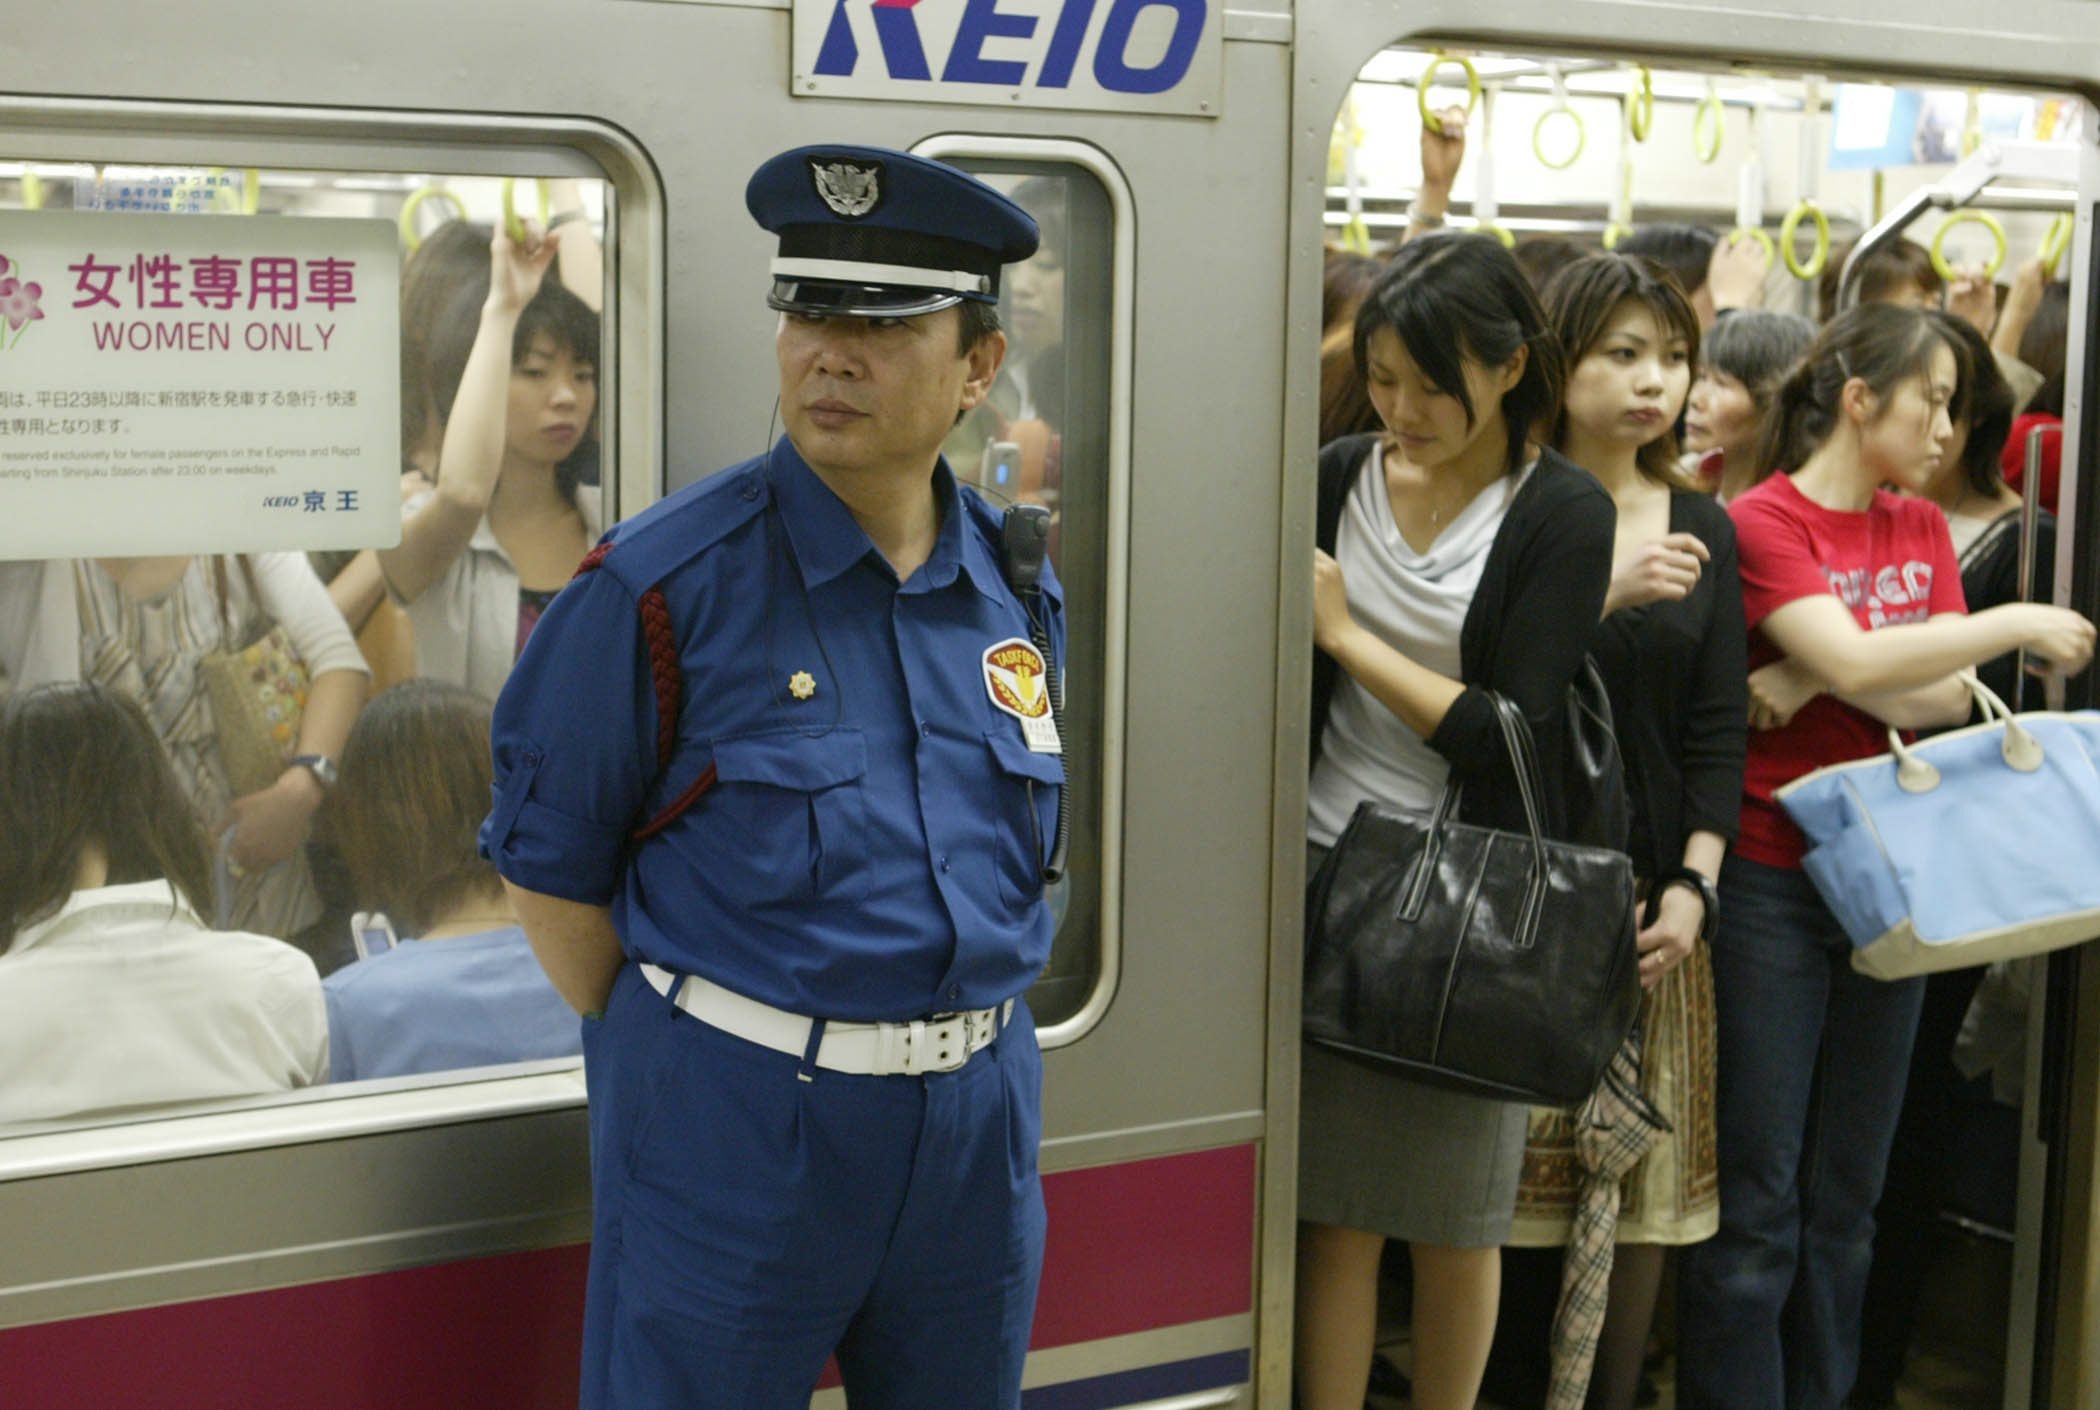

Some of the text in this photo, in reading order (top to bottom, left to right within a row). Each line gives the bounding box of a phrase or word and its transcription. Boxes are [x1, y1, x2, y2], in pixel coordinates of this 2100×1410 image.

[813, 0, 1207, 94] KEIO
[68, 253, 357, 311] 女性専用車
[93, 322, 336, 351] WOMEN ONLY
[2, 451, 49, 461] reserved
[113, 450, 127, 459] for
[168, 450, 228, 461] passengers
[231, 450, 244, 458] on
[247, 448, 263, 457] the
[266, 447, 306, 459] Express
[310, 447, 329, 456] and
[331, 446, 361, 458] Rapid
[111, 466, 147, 476] Station
[263, 490, 359, 512] KEIO 京王
